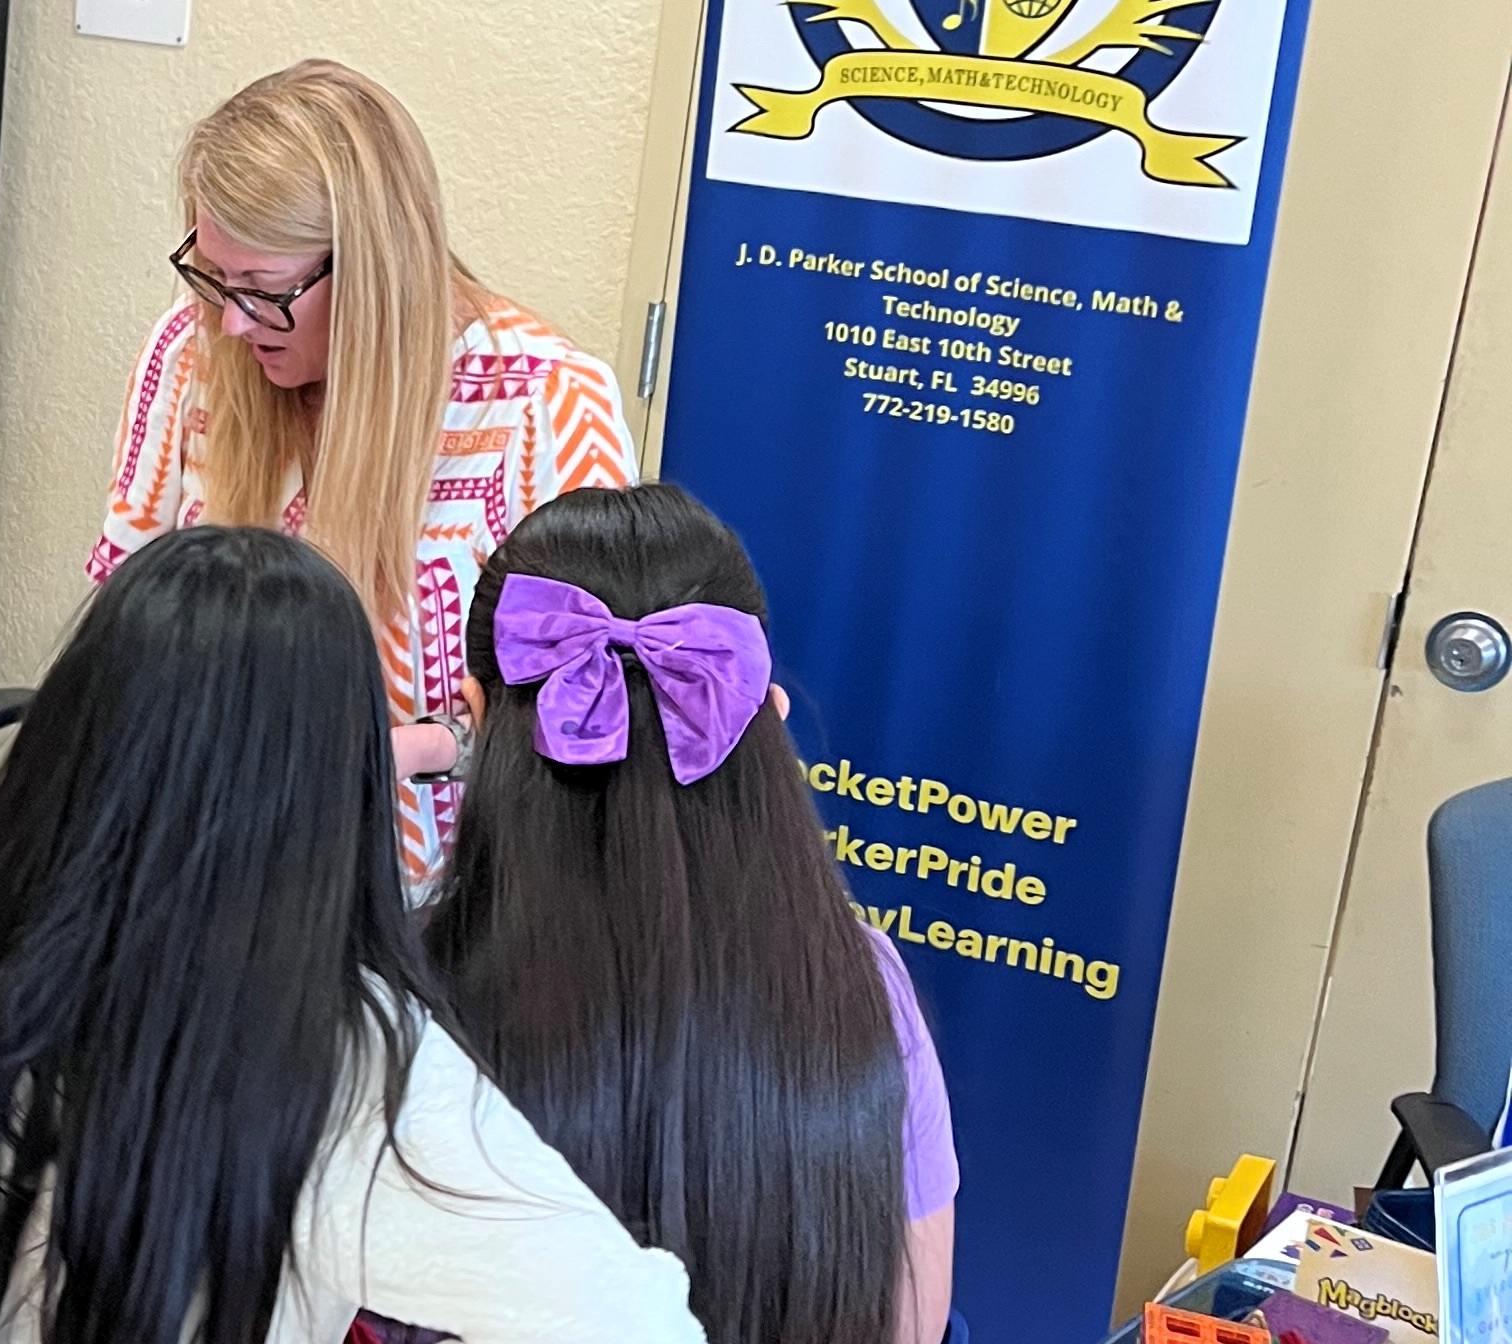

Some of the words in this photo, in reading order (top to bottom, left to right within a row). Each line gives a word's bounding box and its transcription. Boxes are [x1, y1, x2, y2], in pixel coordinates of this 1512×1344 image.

[735, 242, 753, 266] J.
[759, 244, 782, 267] D.
[789, 248, 865, 278] Parker
[870, 259, 950, 289] School
[954, 271, 983, 293] of
[985, 274, 1083, 311] Science,
[1091, 289, 1158, 318] Math
[1164, 300, 1185, 323] &
[882, 295, 1021, 338] Technology
[825, 321, 877, 346] 1010
[882, 329, 931, 355] East
[938, 339, 992, 363] 10th
[998, 346, 1073, 376] Street
[844, 358, 924, 390] Stuart,
[931, 371, 958, 393] FL
[971, 375, 1040, 406] 34996
[862, 392, 1015, 435] 772-219-1580
[823, 824, 1047, 905] rkerPride
